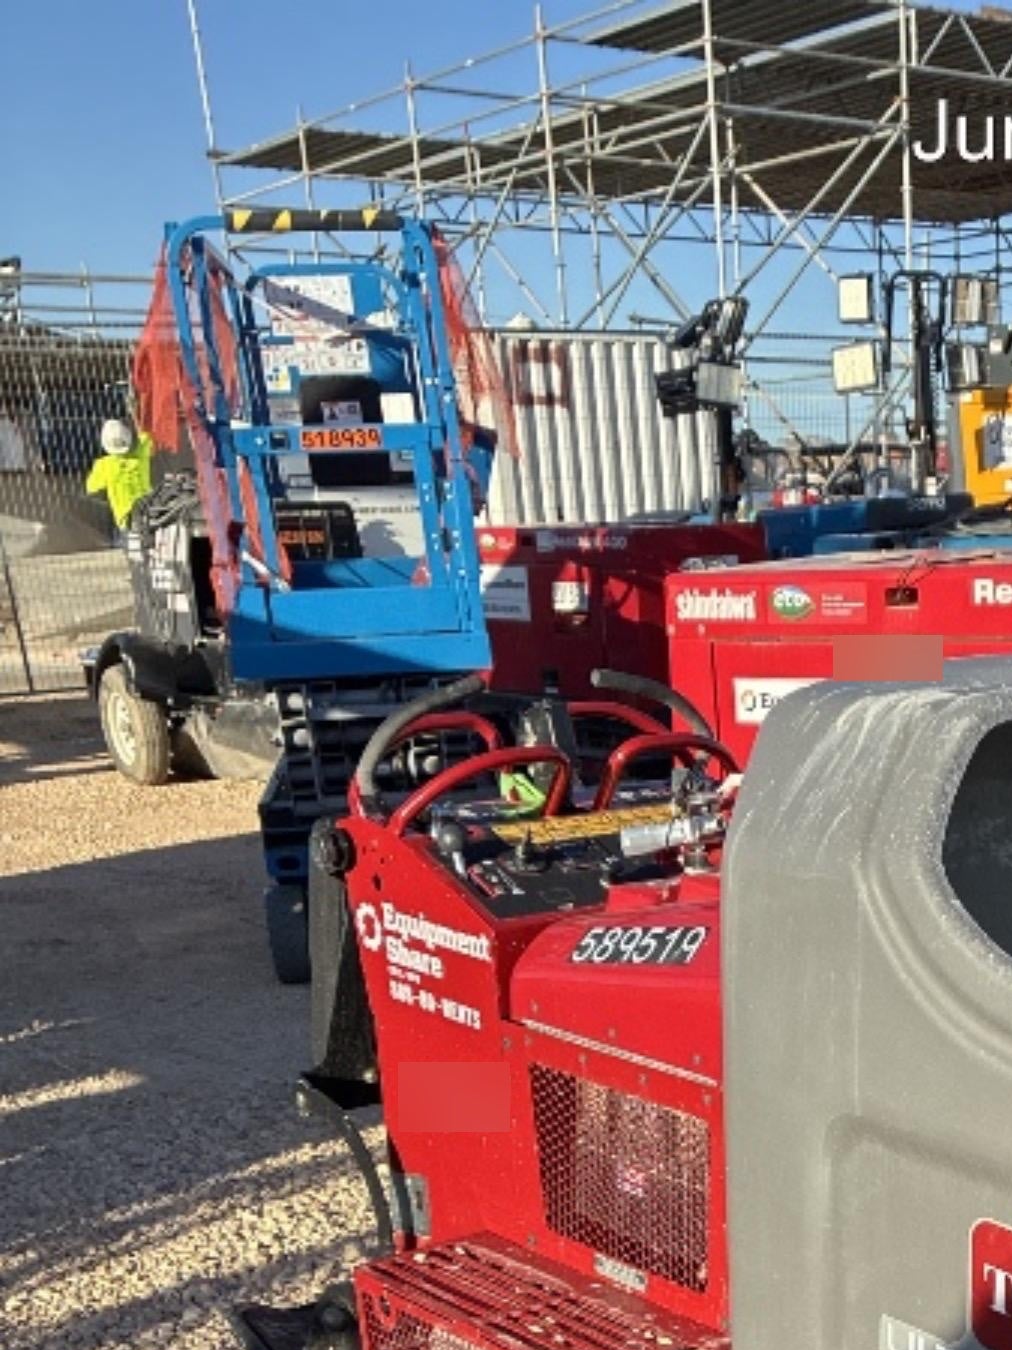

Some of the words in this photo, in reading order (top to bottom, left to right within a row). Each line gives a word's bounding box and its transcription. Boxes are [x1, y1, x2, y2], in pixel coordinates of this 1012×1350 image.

[301, 428, 382, 448] 518939
[381, 902, 492, 962] Equipment
[572, 927, 706, 964] 589519
[385, 935, 445, 979] Share
